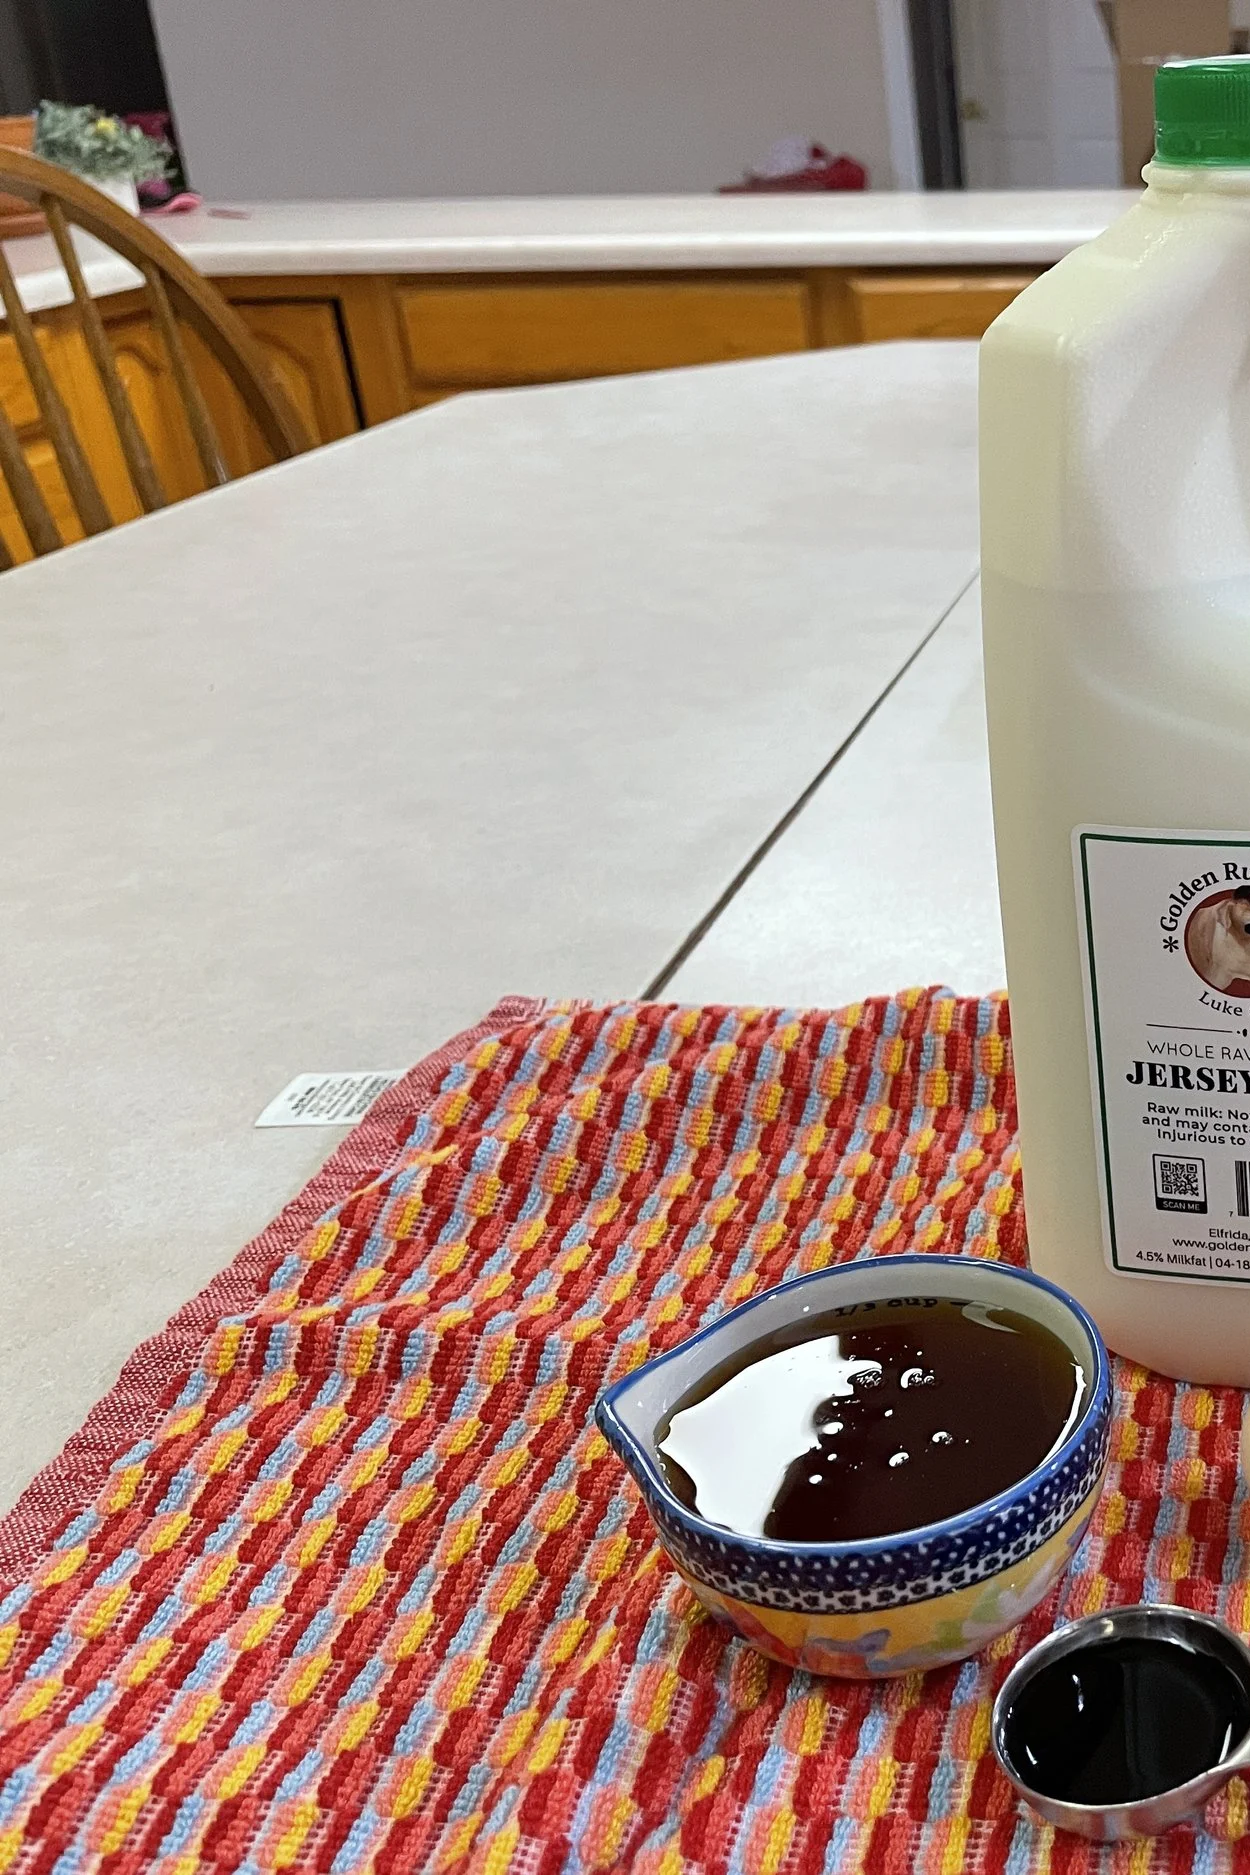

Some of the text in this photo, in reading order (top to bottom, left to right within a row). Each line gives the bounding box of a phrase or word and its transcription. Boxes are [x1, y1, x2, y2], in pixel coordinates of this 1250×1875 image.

[1160, 871, 1220, 932] Golden
[1198, 991, 1243, 1017] Luke
[1147, 1040, 1214, 1059] WHOLE
[1147, 1102, 1180, 1115] Raw
[1185, 1106, 1222, 1119] milk:
[1142, 1116, 1170, 1127] and
[1176, 1120, 1208, 1132] may
[1230, 1135, 1246, 1146] to
[1162, 1200, 1200, 1211] SCAN ME
[1208, 1228, 1250, 1241] Elfrida,
[1136, 1250, 1164, 1263] 4.5%
[1167, 1253, 1207, 1267] Milkfat
[834, 1298, 938, 1317] 1/3 cup
